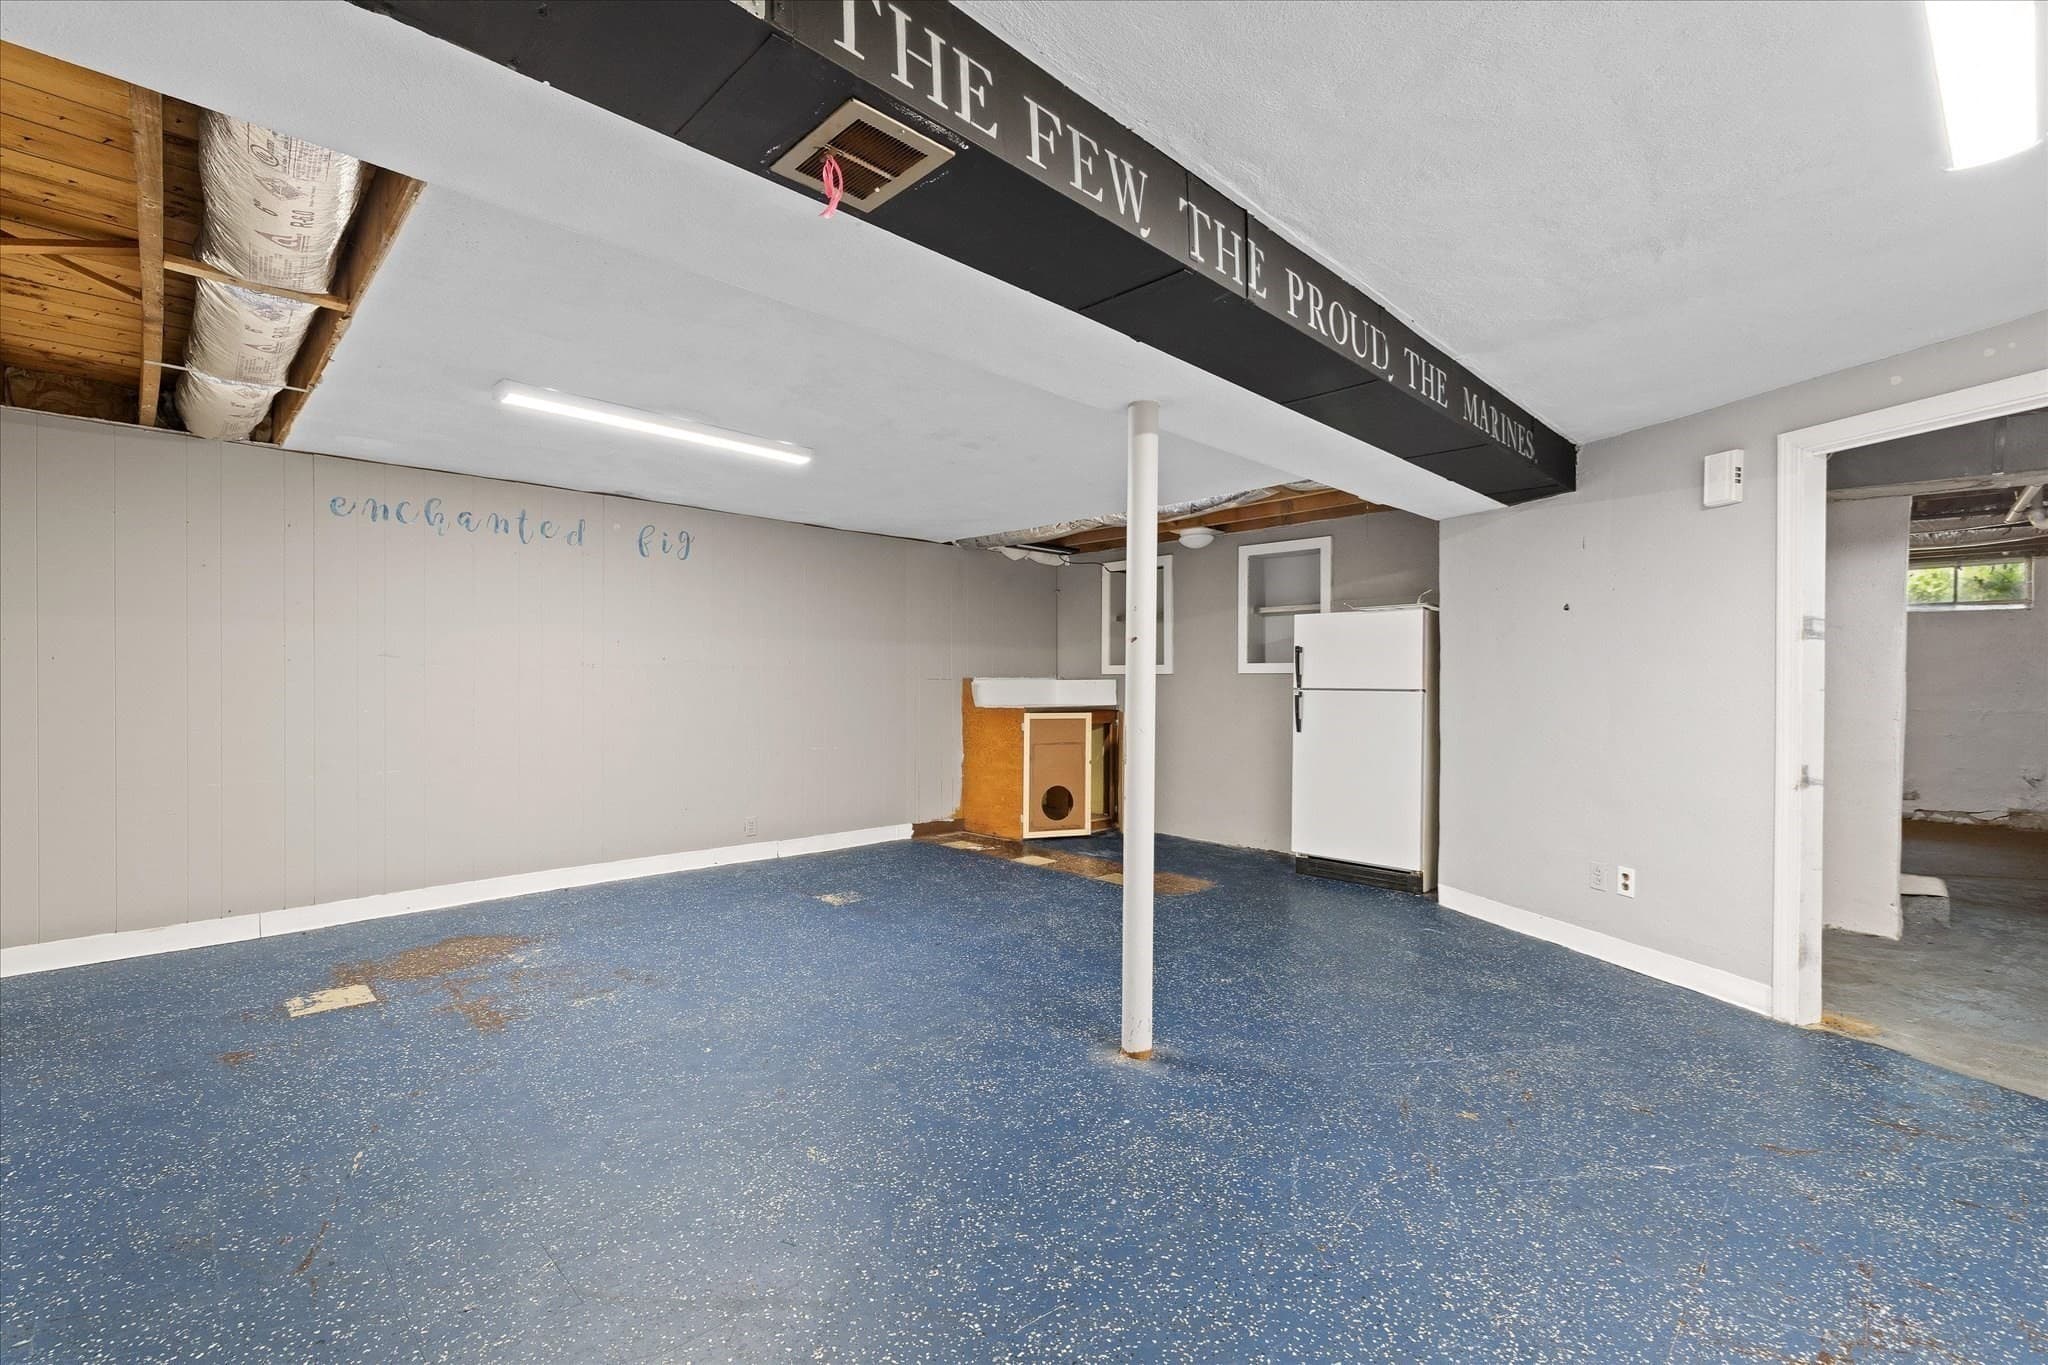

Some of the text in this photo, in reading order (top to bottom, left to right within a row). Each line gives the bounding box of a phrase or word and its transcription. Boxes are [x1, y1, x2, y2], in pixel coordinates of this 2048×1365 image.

[834, 0, 997, 139] THE
[1179, 197, 1267, 299] THE
[1404, 347, 1448, 408] THE
[330, 496, 696, 560] enchanted fig
